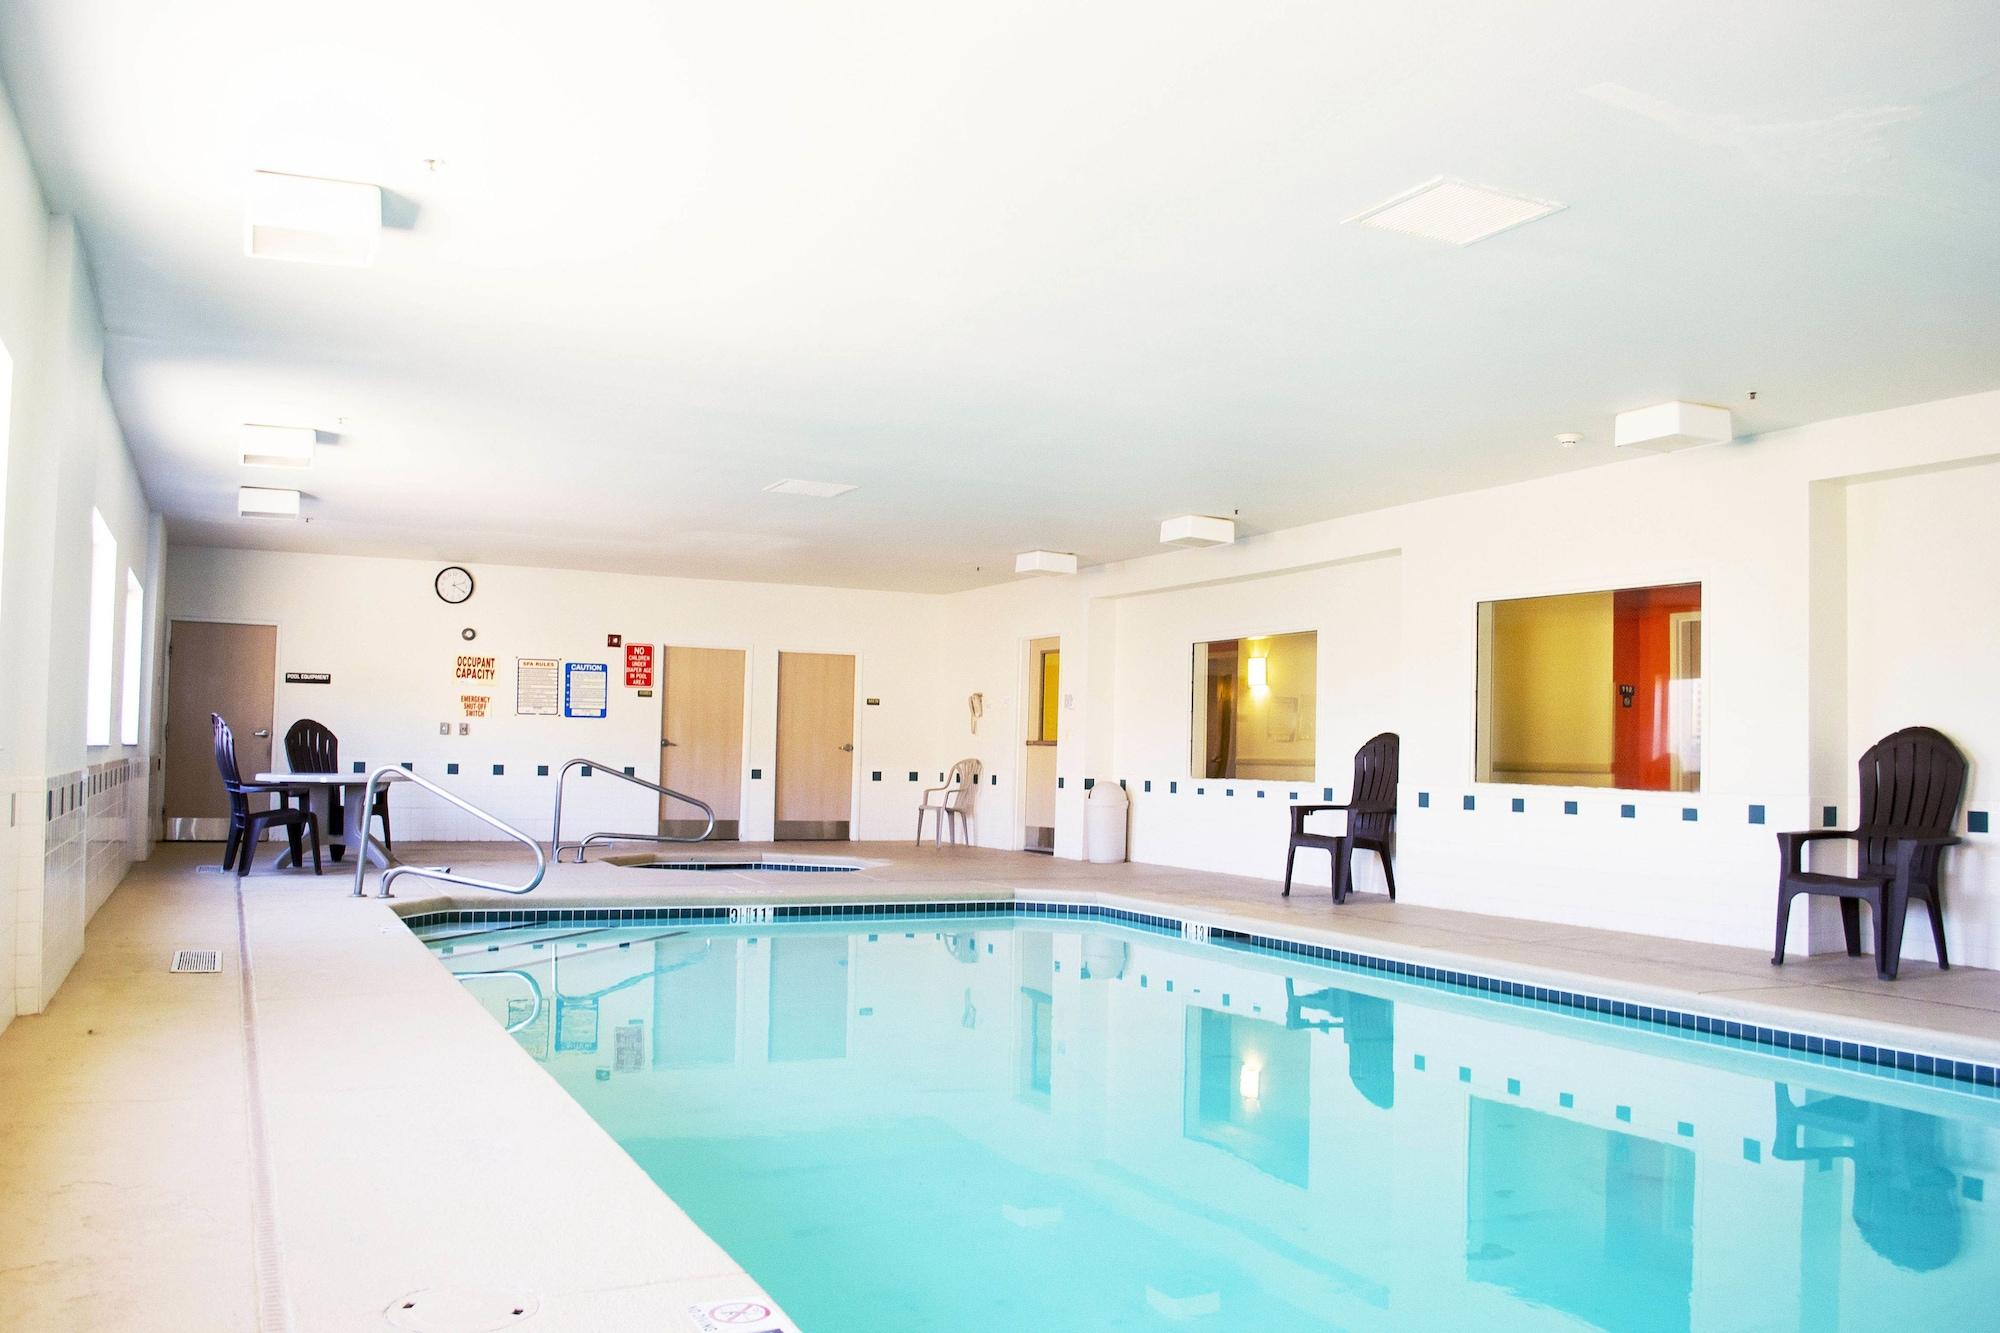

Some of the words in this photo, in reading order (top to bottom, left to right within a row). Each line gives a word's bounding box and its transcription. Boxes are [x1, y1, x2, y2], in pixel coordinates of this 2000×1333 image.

[634, 646, 645, 655] NO
[457, 656, 495, 668] OCCUPANT
[456, 668, 495, 680] CAPACITY
